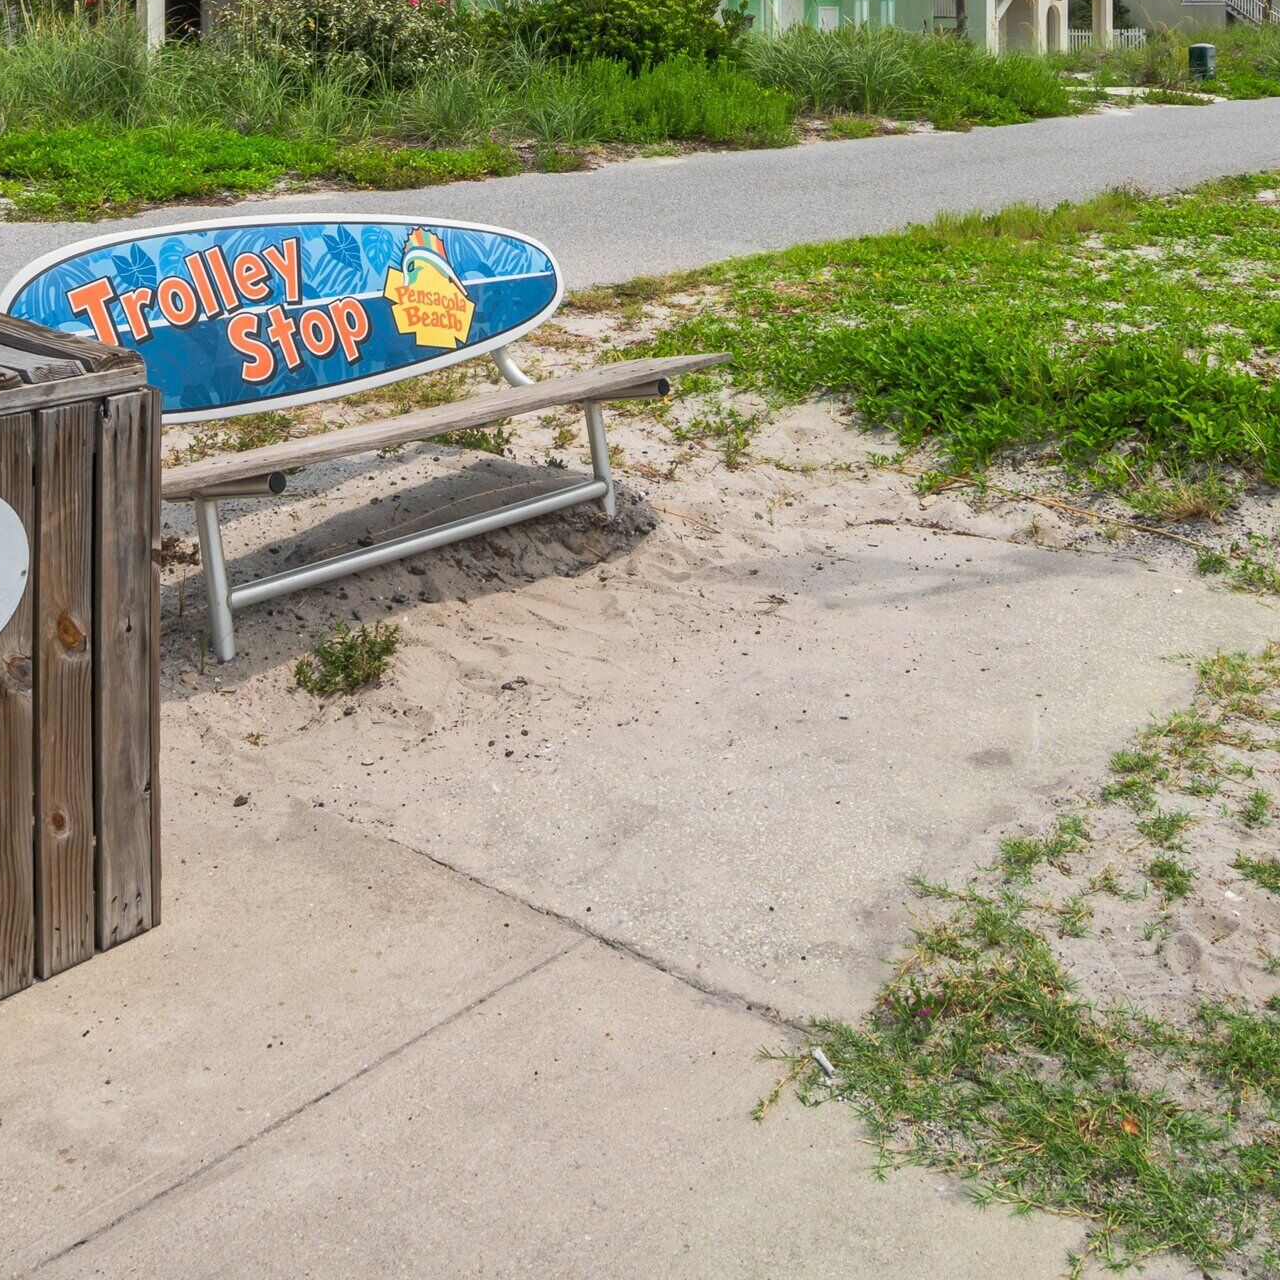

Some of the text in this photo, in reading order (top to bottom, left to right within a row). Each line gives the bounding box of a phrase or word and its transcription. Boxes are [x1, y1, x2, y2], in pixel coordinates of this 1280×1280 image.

[67, 237, 304, 346] Trolley
[395, 285, 467, 313] Pensacola
[403, 306, 463, 332] Beach
[225, 296, 373, 386] Stop
